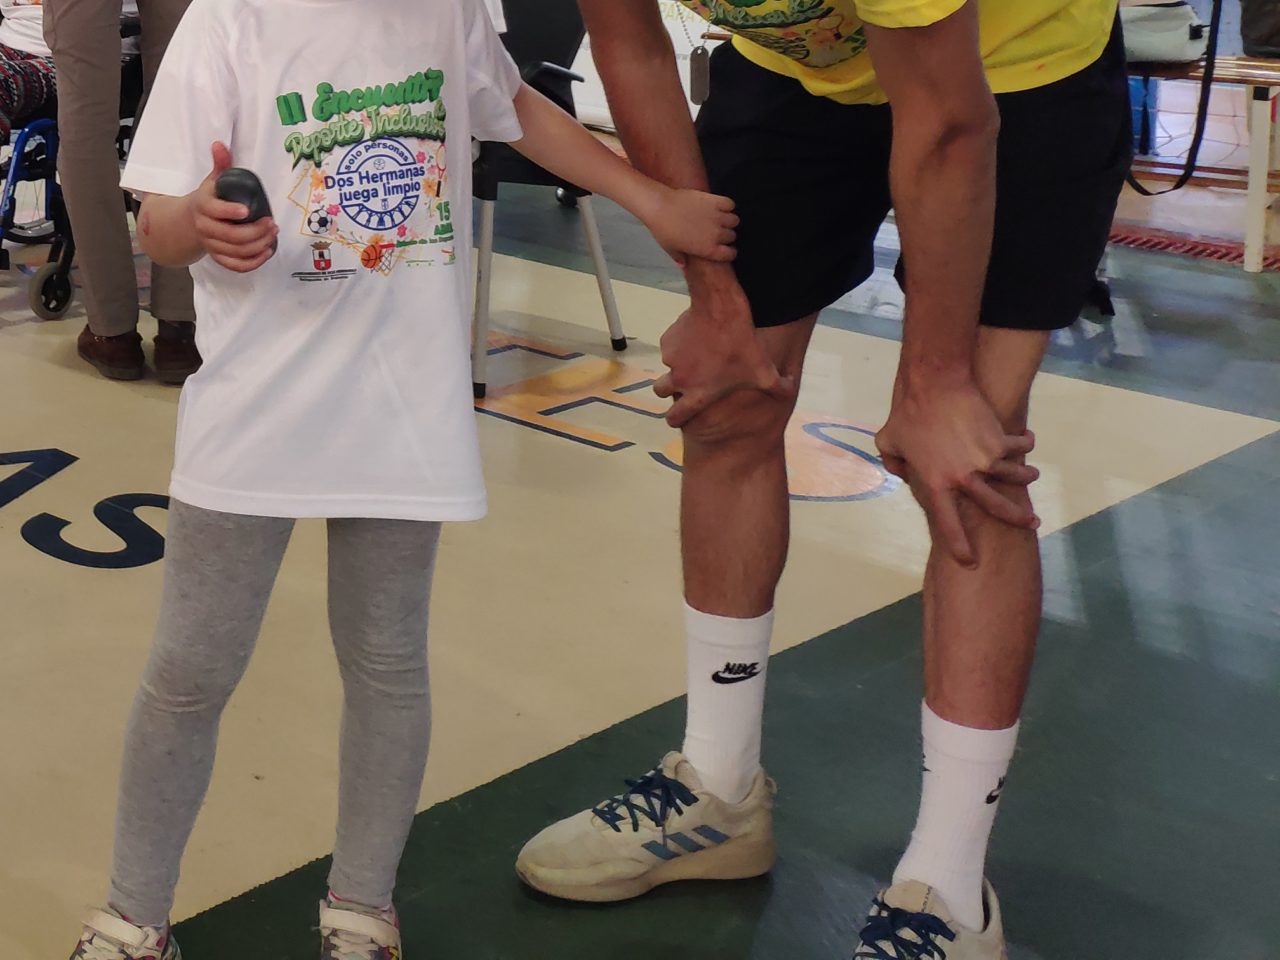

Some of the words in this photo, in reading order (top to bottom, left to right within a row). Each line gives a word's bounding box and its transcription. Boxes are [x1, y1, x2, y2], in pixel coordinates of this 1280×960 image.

[345, 149, 362, 171] solo
[364, 142, 409, 162] personas
[324, 175, 354, 189] Dos
[358, 166, 425, 185] Hermanas
[338, 187, 379, 205] juega
[383, 179, 421, 197] limpio
[436, 201, 450, 221] 15
[720, 662, 760, 676] NIKE
